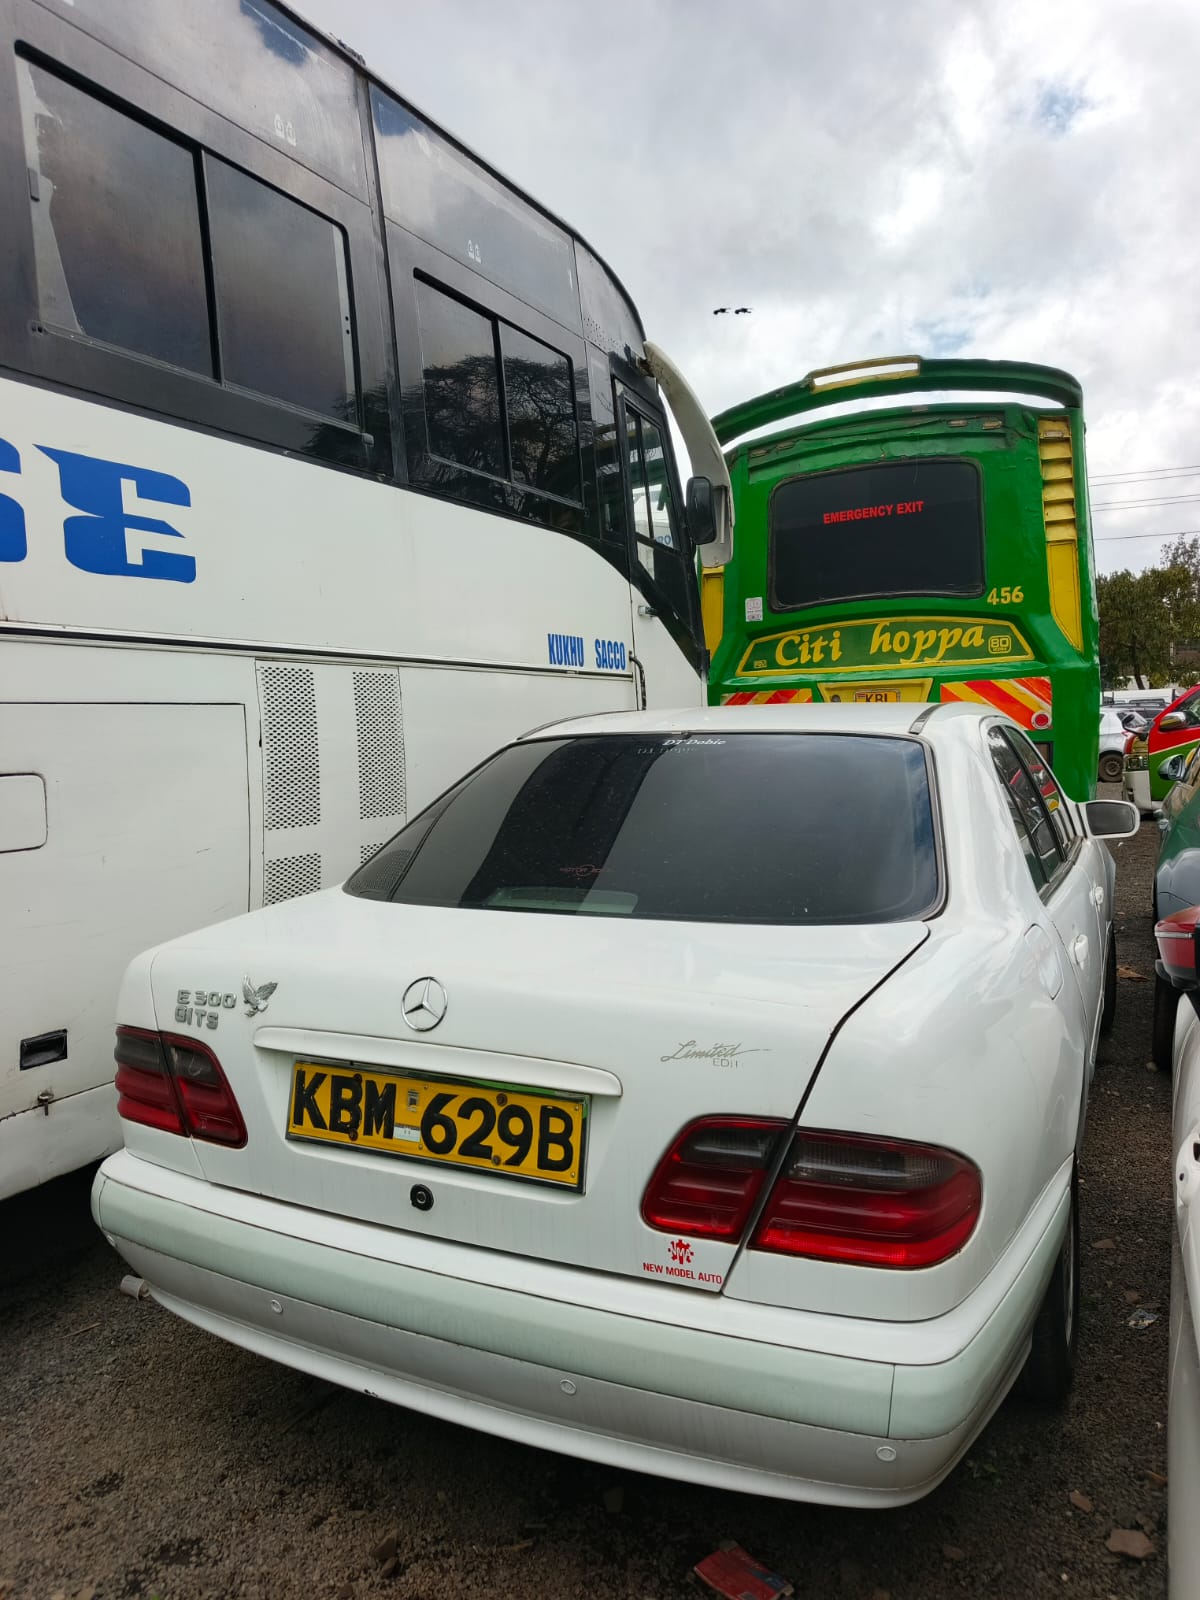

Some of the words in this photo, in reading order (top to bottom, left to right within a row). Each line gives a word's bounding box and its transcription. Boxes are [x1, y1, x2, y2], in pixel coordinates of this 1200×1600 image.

[823, 505, 893, 524] EMERGENCY
[896, 501, 924, 515] EXIT
[987, 585, 1024, 606] 456
[547, 633, 584, 667] KUKHU
[594, 638, 626, 670] SACCO
[775, 630, 842, 666] Citi
[869, 621, 985, 664] hoppa
[176, 989, 191, 1005] E
[193, 990, 237, 1009] 300
[293, 1069, 397, 1140] KBM
[420, 1092, 574, 1172] 629B
[643, 1262, 663, 1274] NEW
[665, 1266, 696, 1280] MODEL
[698, 1272, 722, 1285] AUTO
